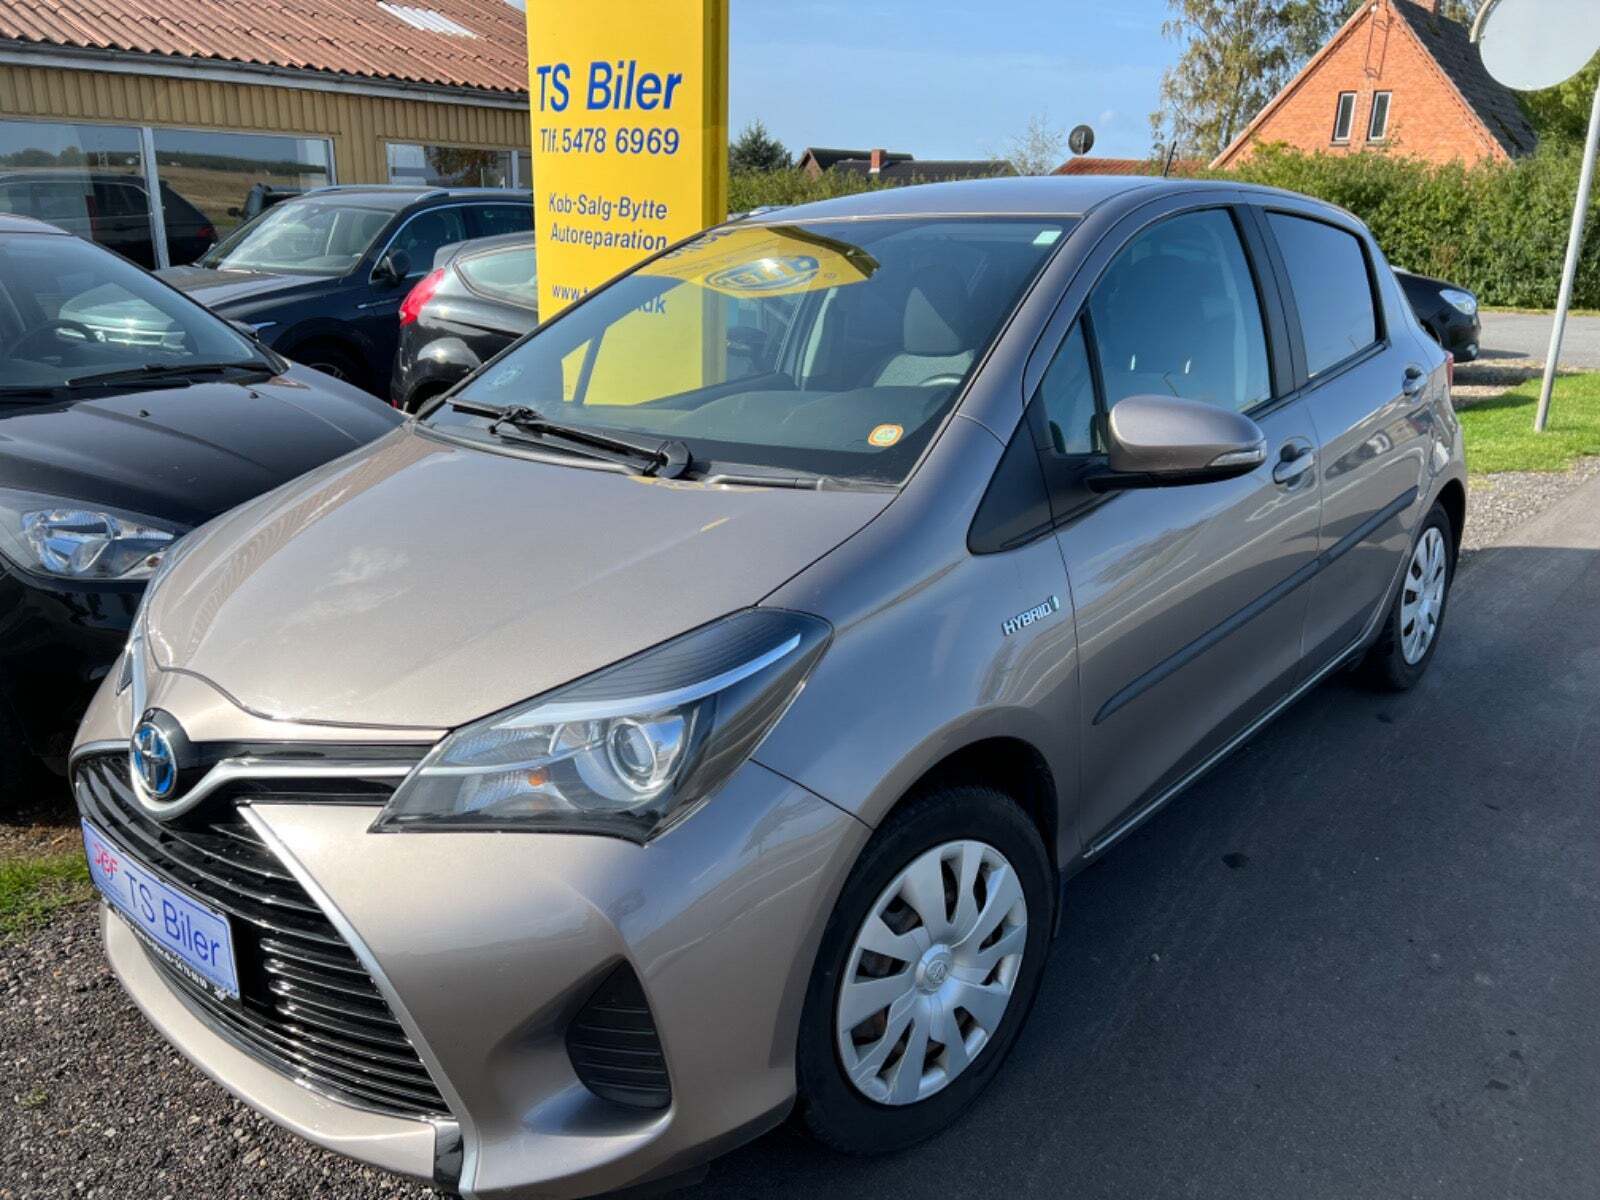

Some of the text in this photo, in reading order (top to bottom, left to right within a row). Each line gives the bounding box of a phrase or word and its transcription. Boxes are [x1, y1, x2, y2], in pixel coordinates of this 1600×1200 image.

[536, 60, 683, 112] TS Biler
[616, 127, 680, 155] 6969
[551, 222, 668, 250] Autoreparation
[1001, 601, 1053, 636] HYBRID
[123, 870, 156, 924] TS
[161, 899, 221, 967] Biler
